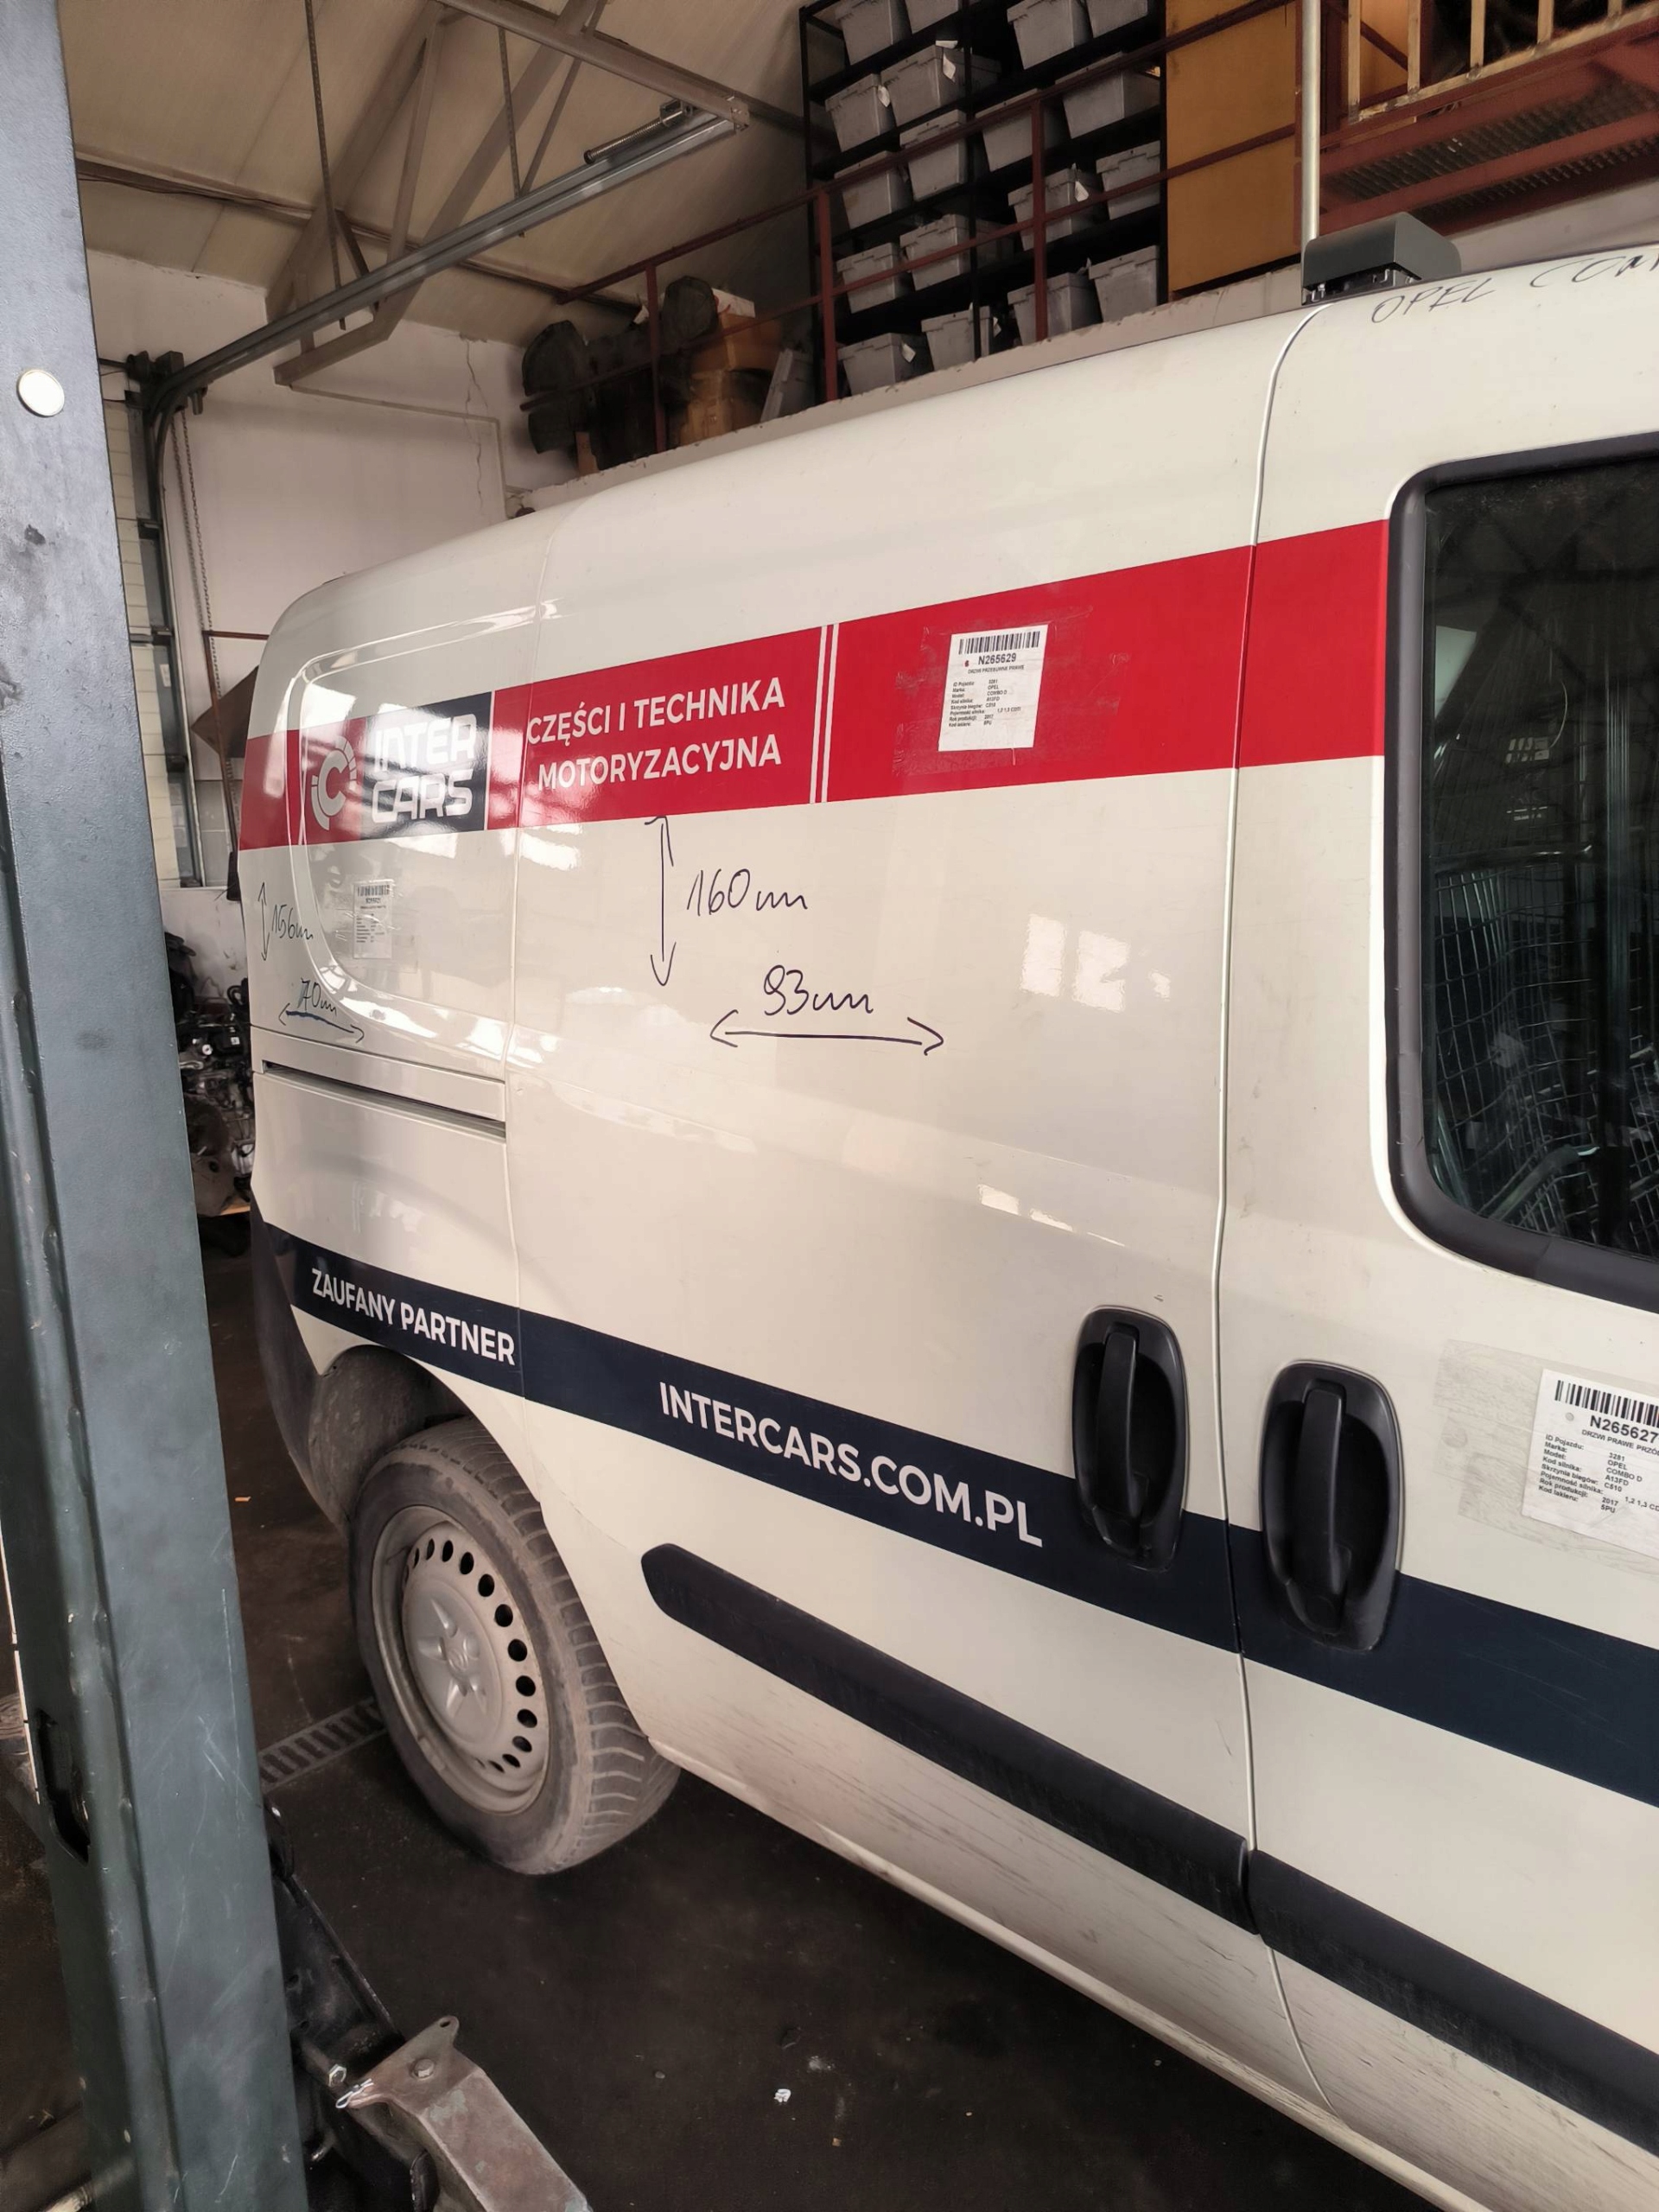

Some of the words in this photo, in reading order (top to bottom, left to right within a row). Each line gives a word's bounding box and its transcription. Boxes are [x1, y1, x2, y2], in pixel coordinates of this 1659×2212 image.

[1370, 277, 1496, 323] OPEL
[978, 652, 1017, 664] N265629
[527, 701, 611, 747] CZĘŚCI
[619, 702, 626, 731] I
[633, 677, 785, 728] TECHNIKA
[373, 713, 477, 772] INTER
[537, 734, 782, 791] MOTORYZACYJNA
[372, 768, 474, 823] CARS
[311, 1268, 396, 1325] ZAUFANY
[400, 1301, 515, 1366] PARTNER
[1582, 1429, 1605, 1440] DRZWI
[1607, 1436, 1634, 1449] PRAWE
[1590, 1415, 1659, 1443] N265627
[1545, 1441, 1567, 1452] Marka:
[1607, 1459, 1627, 1470] OPEL
[1554, 1436, 1584, 1450] Pojazdu:
[1609, 1452, 1624, 1461] 3281
[659, 1382, 1043, 1548] INTERCARS.COM.PL
[1541, 1463, 1571, 1477] Skrzynia
[1572, 1472, 1599, 1485] biegów:
[1605, 1482, 1622, 1492] C510
[1542, 1456, 1556, 1465] Kod
[1558, 1460, 1581, 1472] silnika:
[1605, 1475, 1629, 1486] A13FD
[1544, 1449, 1566, 1460] Model:
[1606, 1467, 1635, 1480] COMBO
[1539, 1485, 1552, 1494] Kod
[1540, 1478, 1552, 1486] Rok
[1554, 1483, 1588, 1497] produkcji:
[1602, 1497, 1618, 1506] 2017
